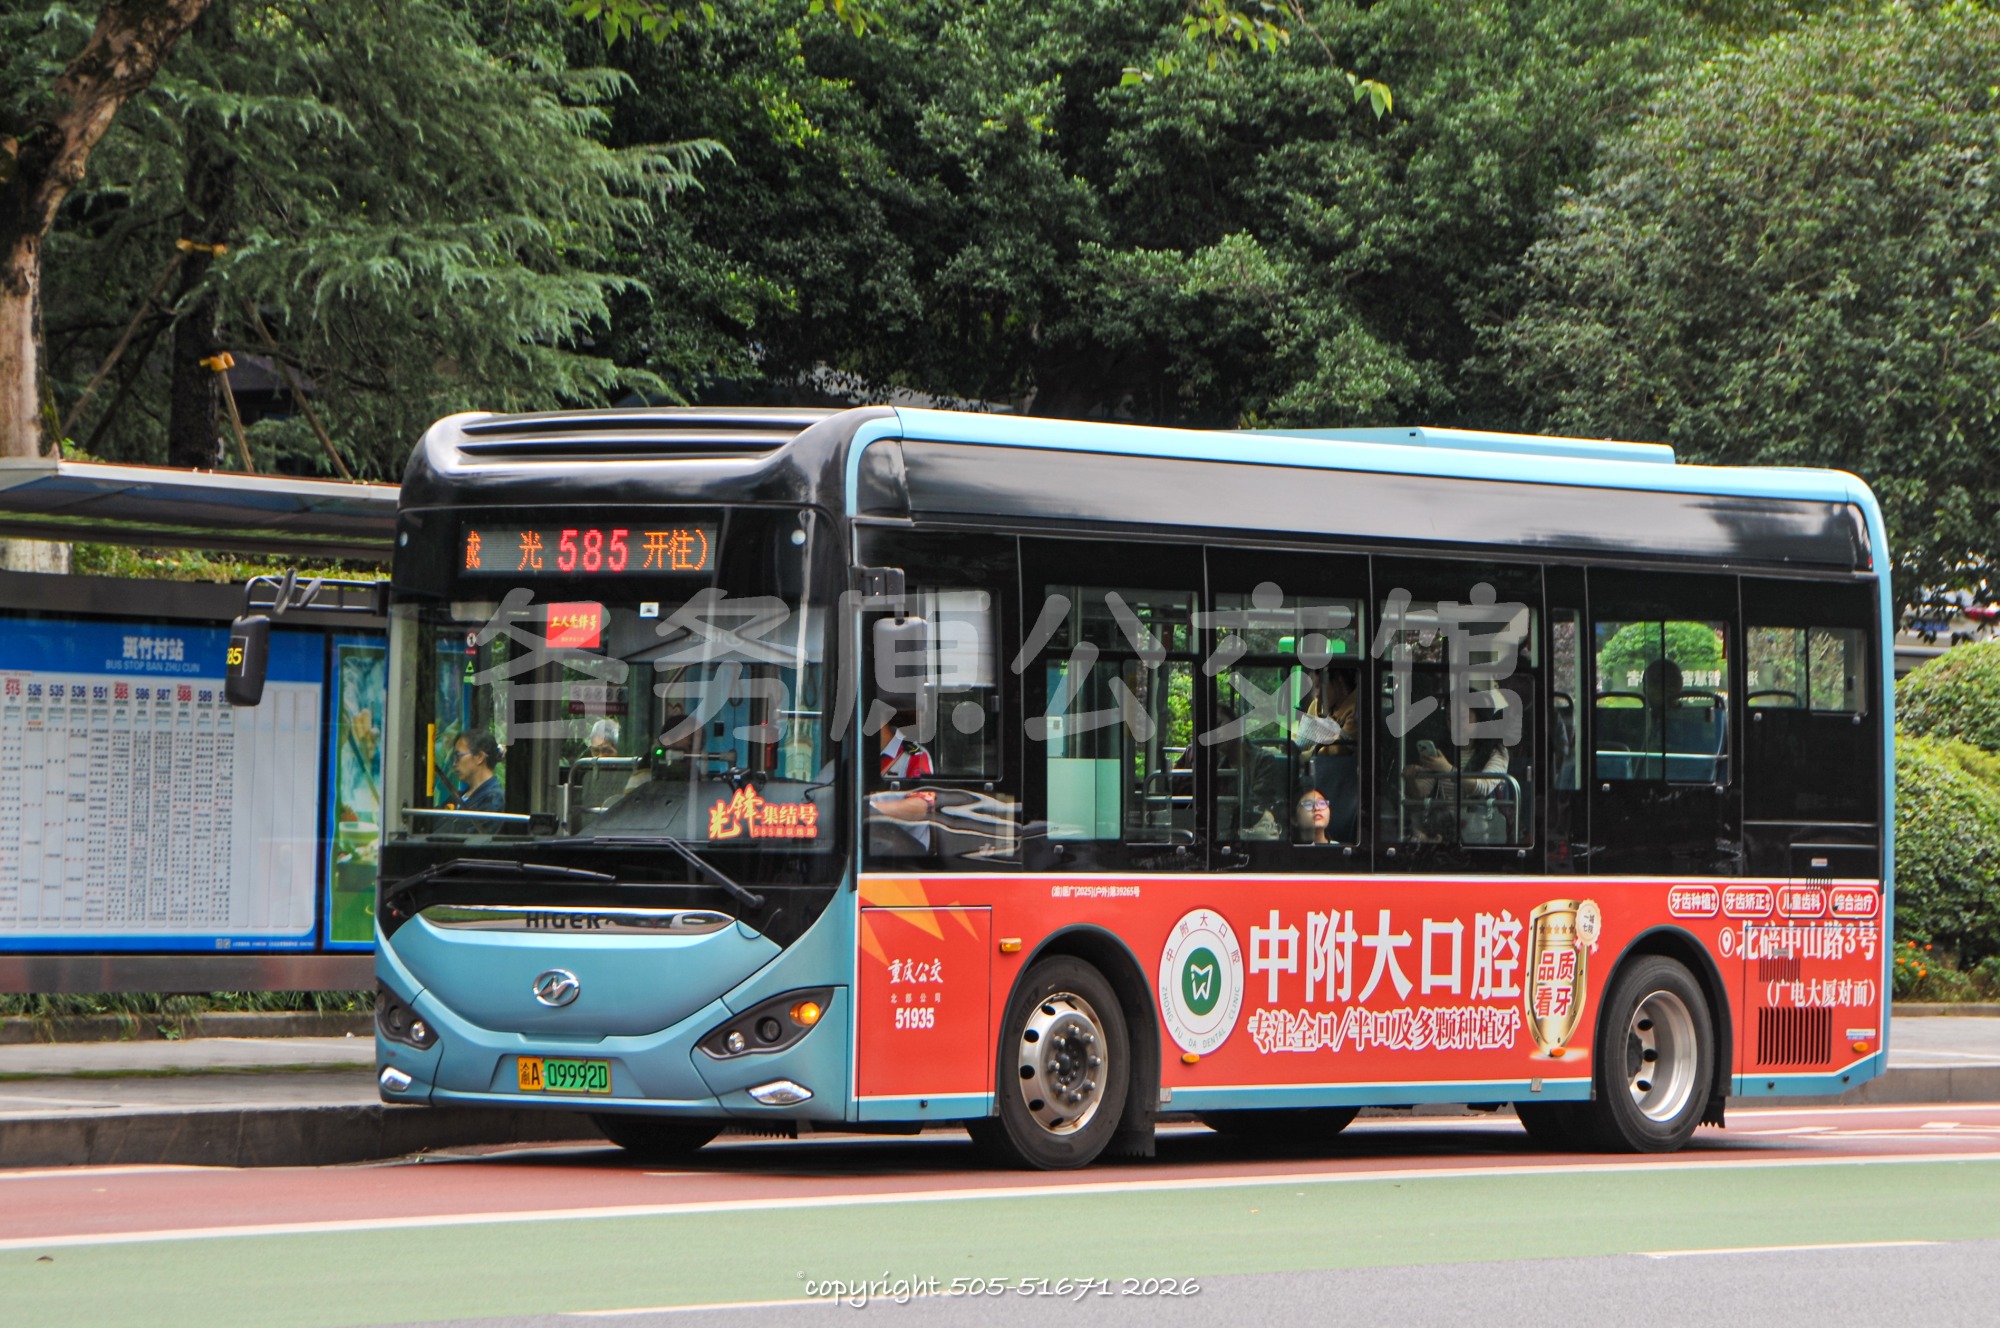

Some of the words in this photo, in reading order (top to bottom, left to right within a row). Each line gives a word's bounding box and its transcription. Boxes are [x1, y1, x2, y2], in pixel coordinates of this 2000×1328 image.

[558, 529, 629, 572] 585
[122, 637, 184, 661] 斑竹村站
[226, 647, 243, 666] 85
[106, 660, 122, 669] BUS
[124, 661, 145, 670] STOP
[146, 662, 162, 671] BAN
[165, 662, 181, 672] ZHU
[182, 663, 200, 672] CUN
[5, 682, 20, 696] 515
[28, 683, 42, 696] 526
[49, 684, 64, 697] 535
[71, 685, 86, 698] 536
[93, 686, 108, 699] 551
[136, 688, 149, 700] 586
[157, 689, 171, 701] 587
[1671, 892, 1711, 911] 牙齿种植
[1725, 892, 1765, 911] 牙齿矫正
[1782, 892, 1821, 911] 儿童齿科
[1834, 893, 1874, 912] 综合治疗
[526, 910, 601, 929] HIGER
[1736, 919, 1878, 960] 北碚中山路3号
[1250, 909, 1523, 1003] 中附大口腔
[887, 958, 944, 984] 重庆公交
[1537, 951, 1576, 983] 品质
[1535, 986, 1573, 1018] 看牙
[1767, 978, 1876, 1008] (广电大厦对面)
[895, 1007, 935, 1030] 51935
[1202, 1028, 1227, 1049] DENTAL
[1228, 986, 1241, 1020] CLINIC
[1248, 1006, 1521, 1054] 专注全口/半口及多颗种植牙
[548, 1063, 608, 1089] 09992D
